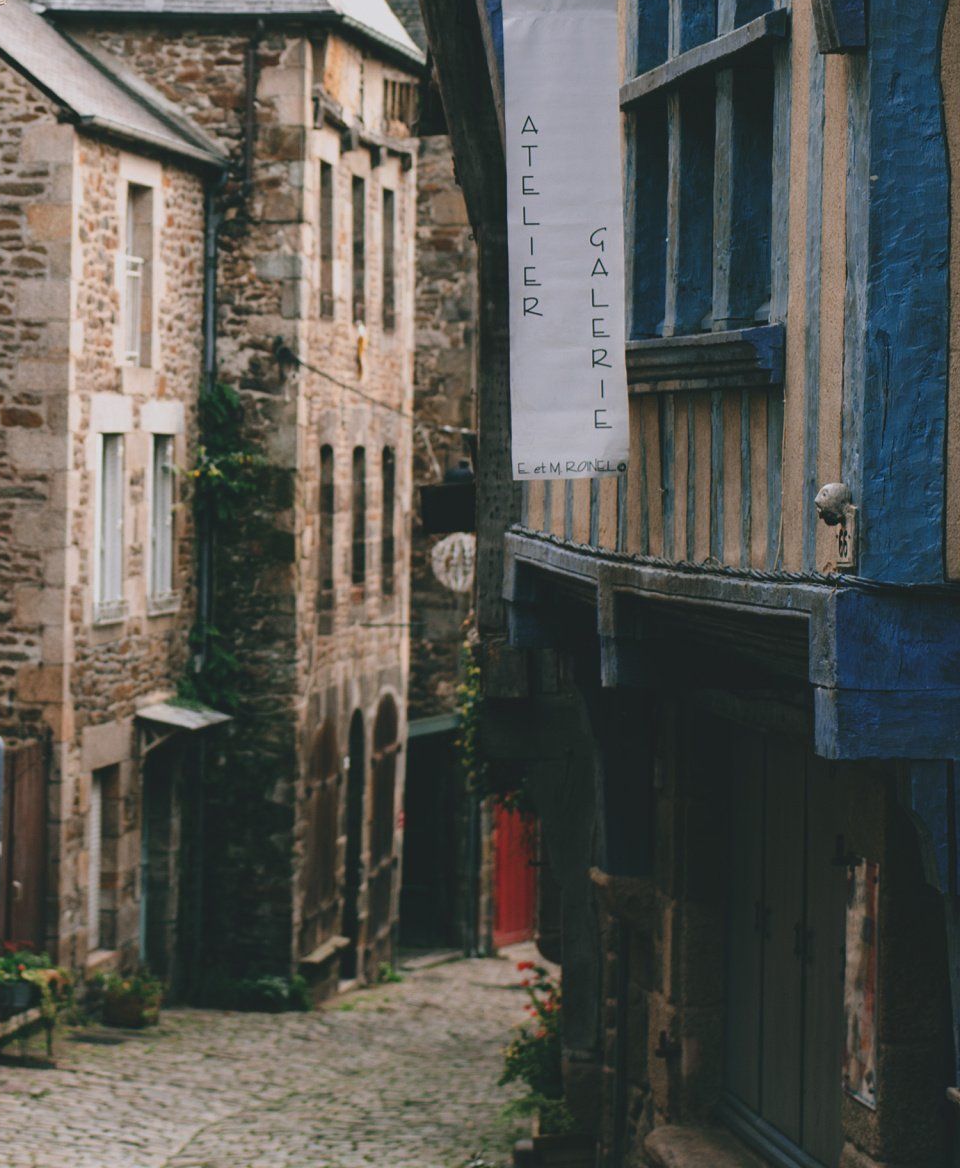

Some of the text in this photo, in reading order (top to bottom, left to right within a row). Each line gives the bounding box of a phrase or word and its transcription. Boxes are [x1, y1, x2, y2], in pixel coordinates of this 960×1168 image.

[520, 115, 543, 316] ATELIER
[589, 227, 612, 429] GALERIE
[533, 461, 547, 474] et
